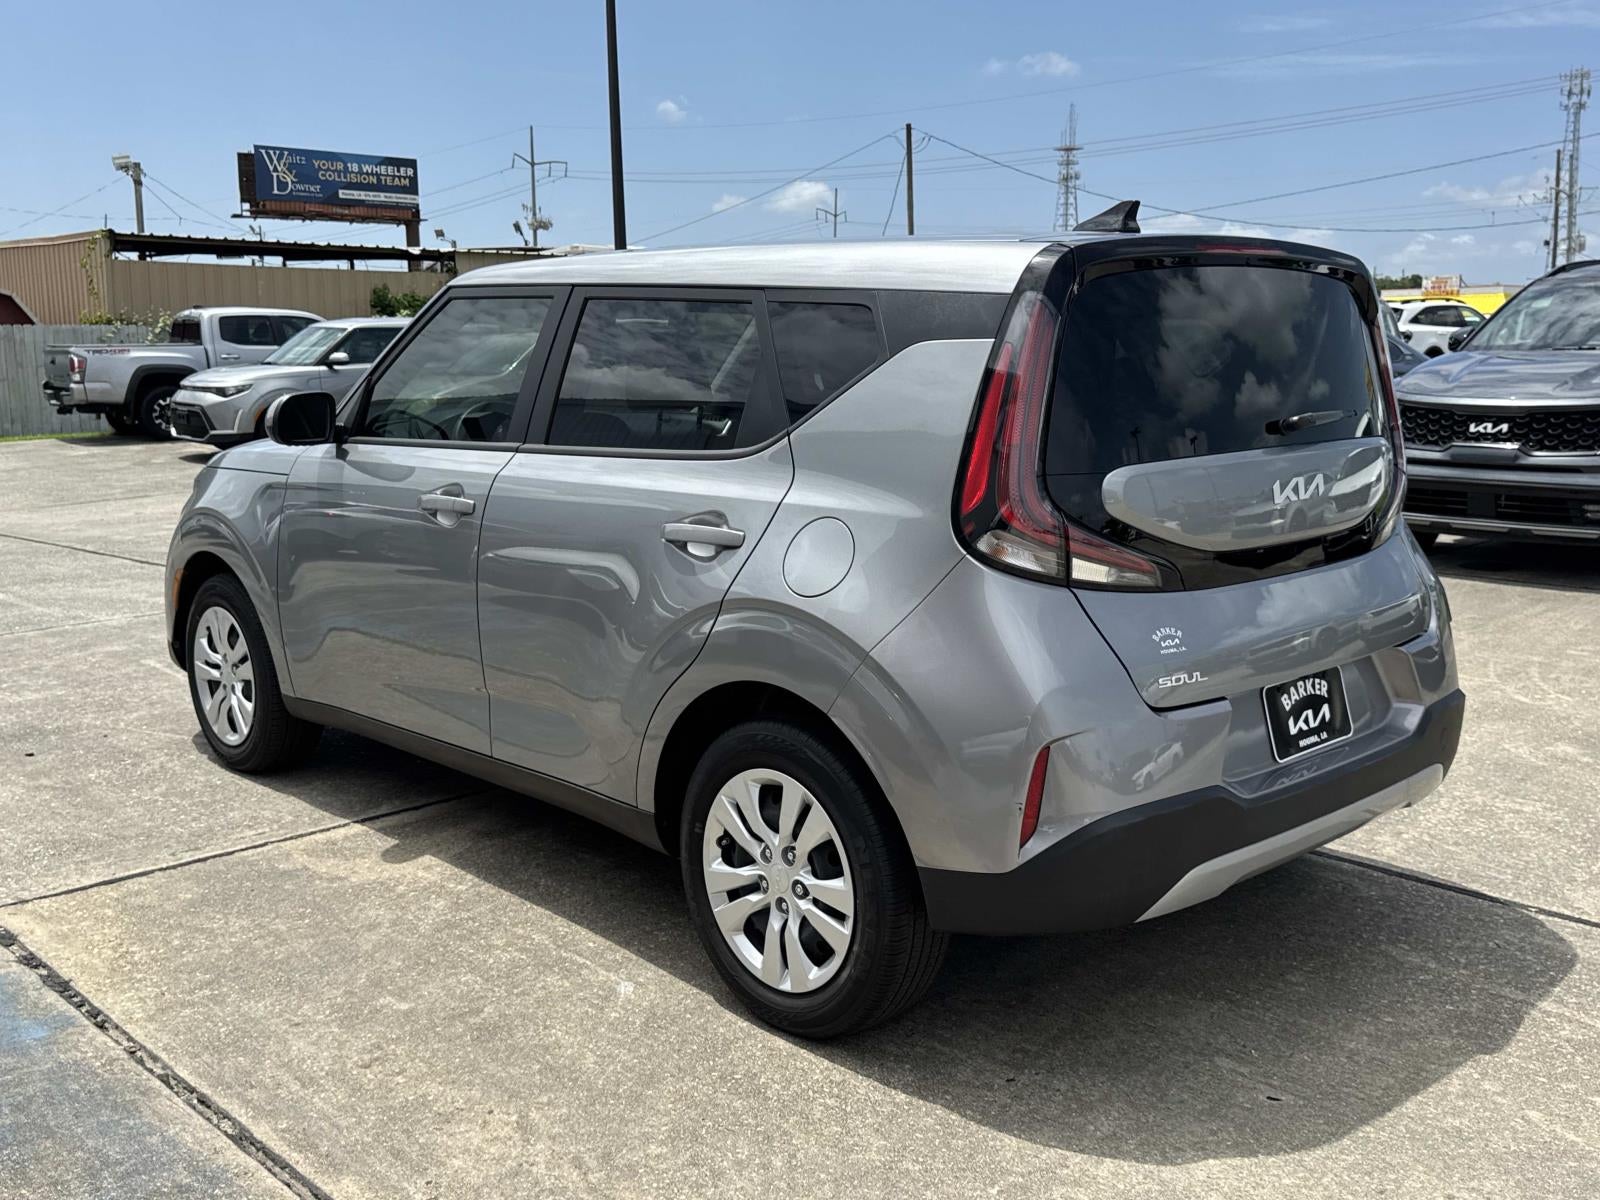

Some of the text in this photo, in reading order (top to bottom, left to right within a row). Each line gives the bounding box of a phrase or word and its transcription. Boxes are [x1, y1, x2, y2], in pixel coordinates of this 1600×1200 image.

[259, 149, 306, 173] Waitz
[313, 159, 414, 177] YOUR 18 WHEELER
[271, 172, 321, 195] Downer
[318, 171, 409, 187] COLLISION TEAM
[1469, 422, 1509, 433] KIA
[1273, 473, 1324, 504] KIA
[1152, 627, 1182, 642] BARKER
[1158, 671, 1208, 689] SOUL
[1281, 678, 1328, 712] BARKER
[1288, 703, 1331, 735] KIA
[1320, 730, 1328, 740] LA
